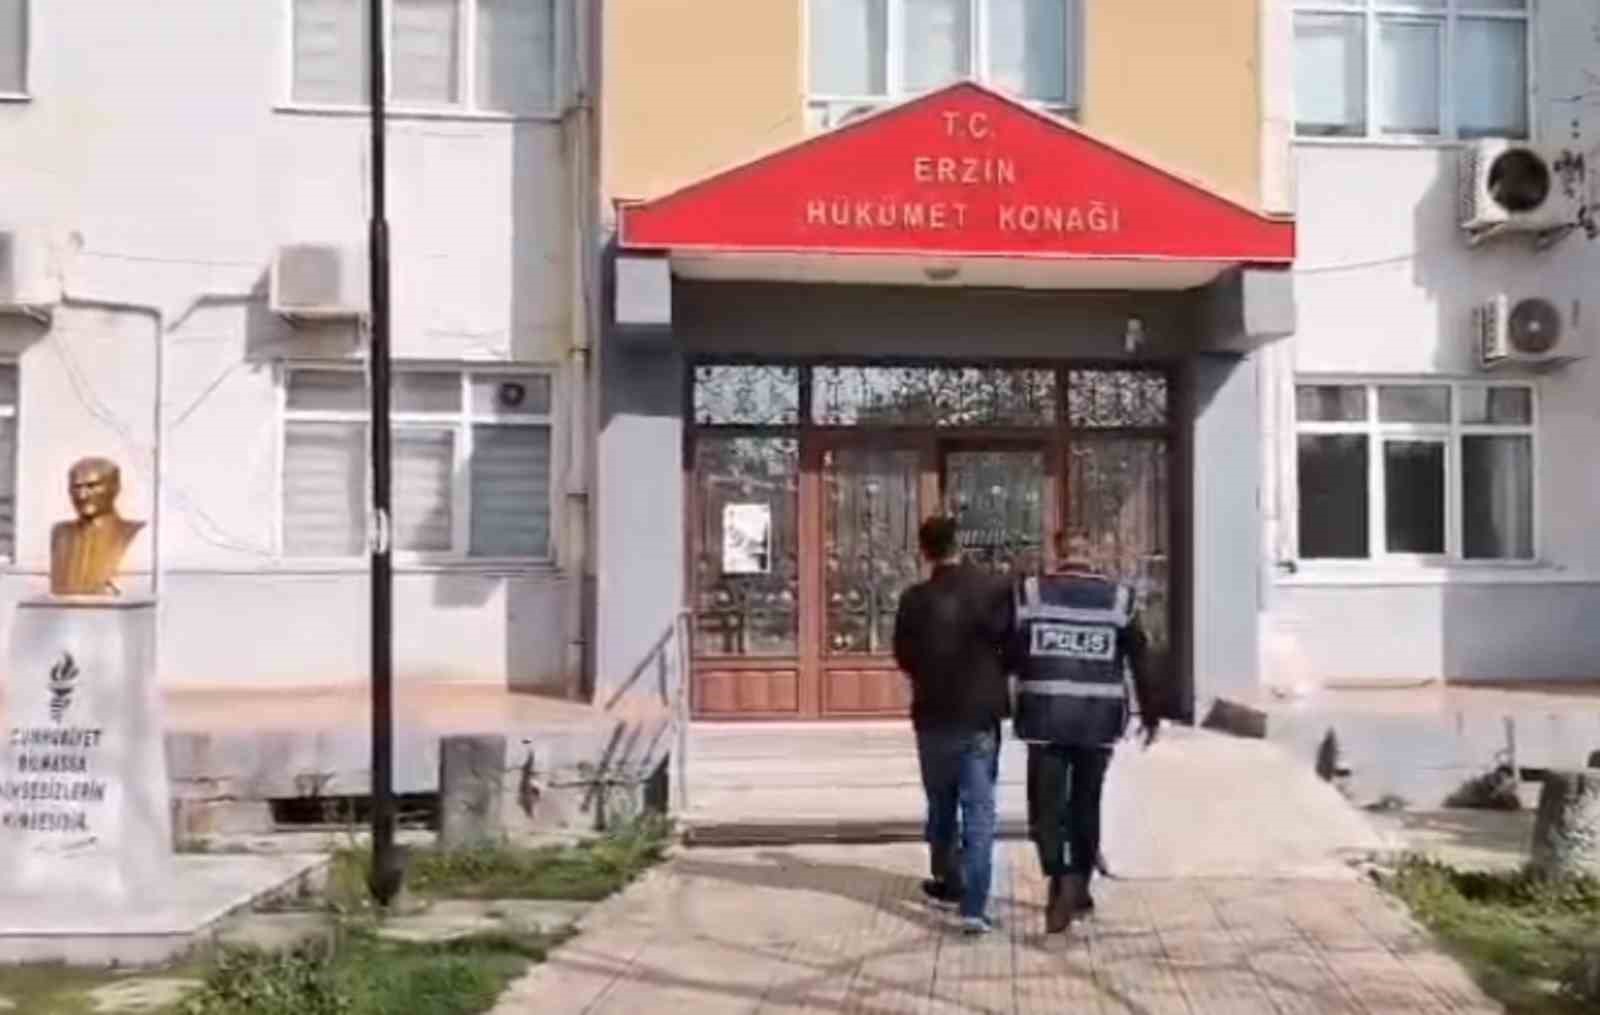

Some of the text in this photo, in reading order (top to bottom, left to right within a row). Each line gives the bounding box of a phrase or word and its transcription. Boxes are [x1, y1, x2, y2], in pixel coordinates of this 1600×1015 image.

[942, 110, 996, 139] T.C.
[806, 196, 1121, 232] HÜKÜMET KONAĞI
